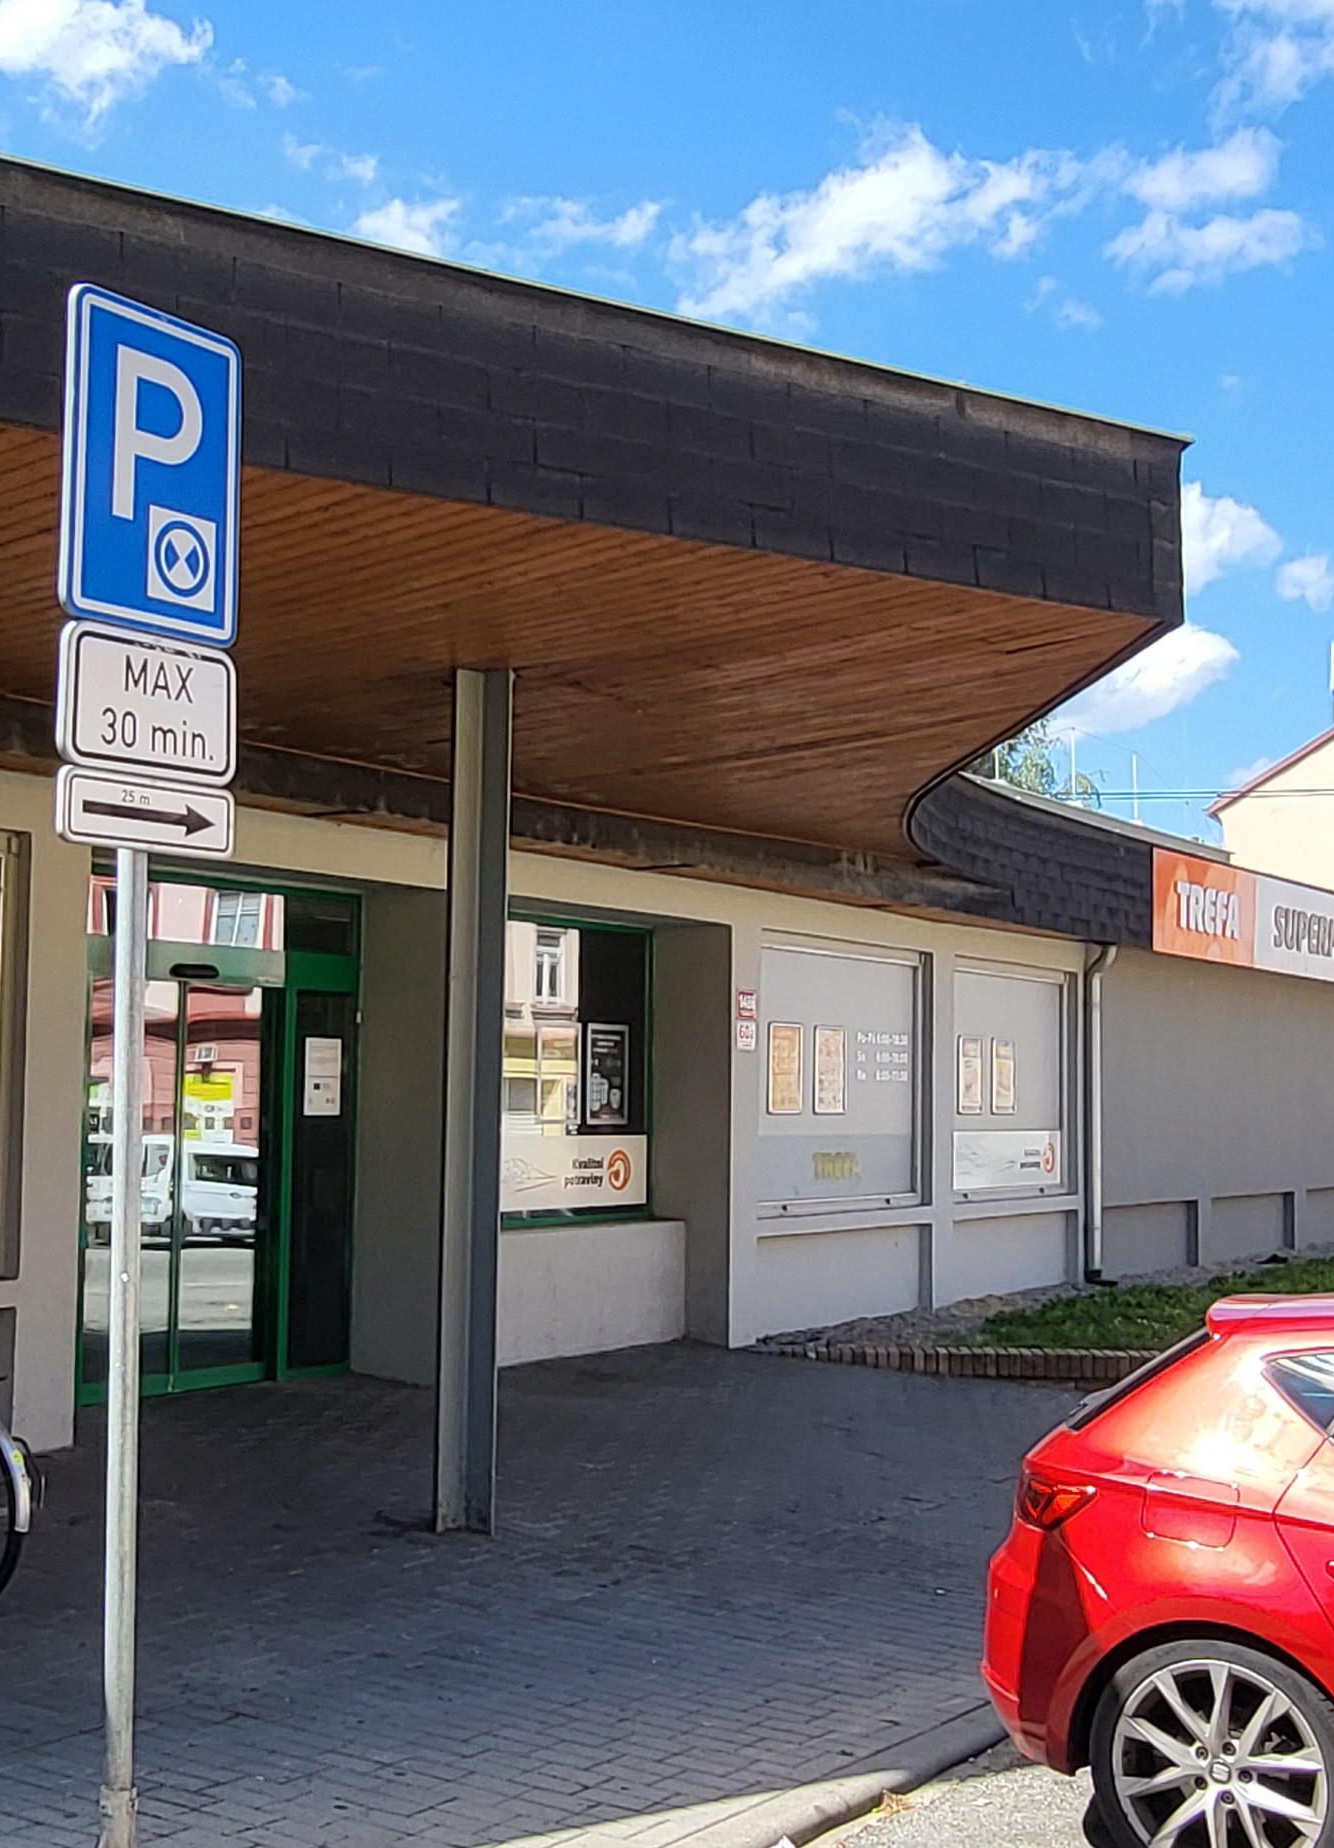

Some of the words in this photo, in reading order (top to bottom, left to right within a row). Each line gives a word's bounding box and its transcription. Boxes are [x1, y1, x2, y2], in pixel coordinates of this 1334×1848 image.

[111, 343, 204, 521] P
[123, 653, 195, 705] MAX
[101, 706, 137, 749] 30
[150, 721, 215, 762] min.
[121, 789, 136, 803] 25
[140, 795, 150, 806] m
[1174, 879, 1240, 941] TREFA
